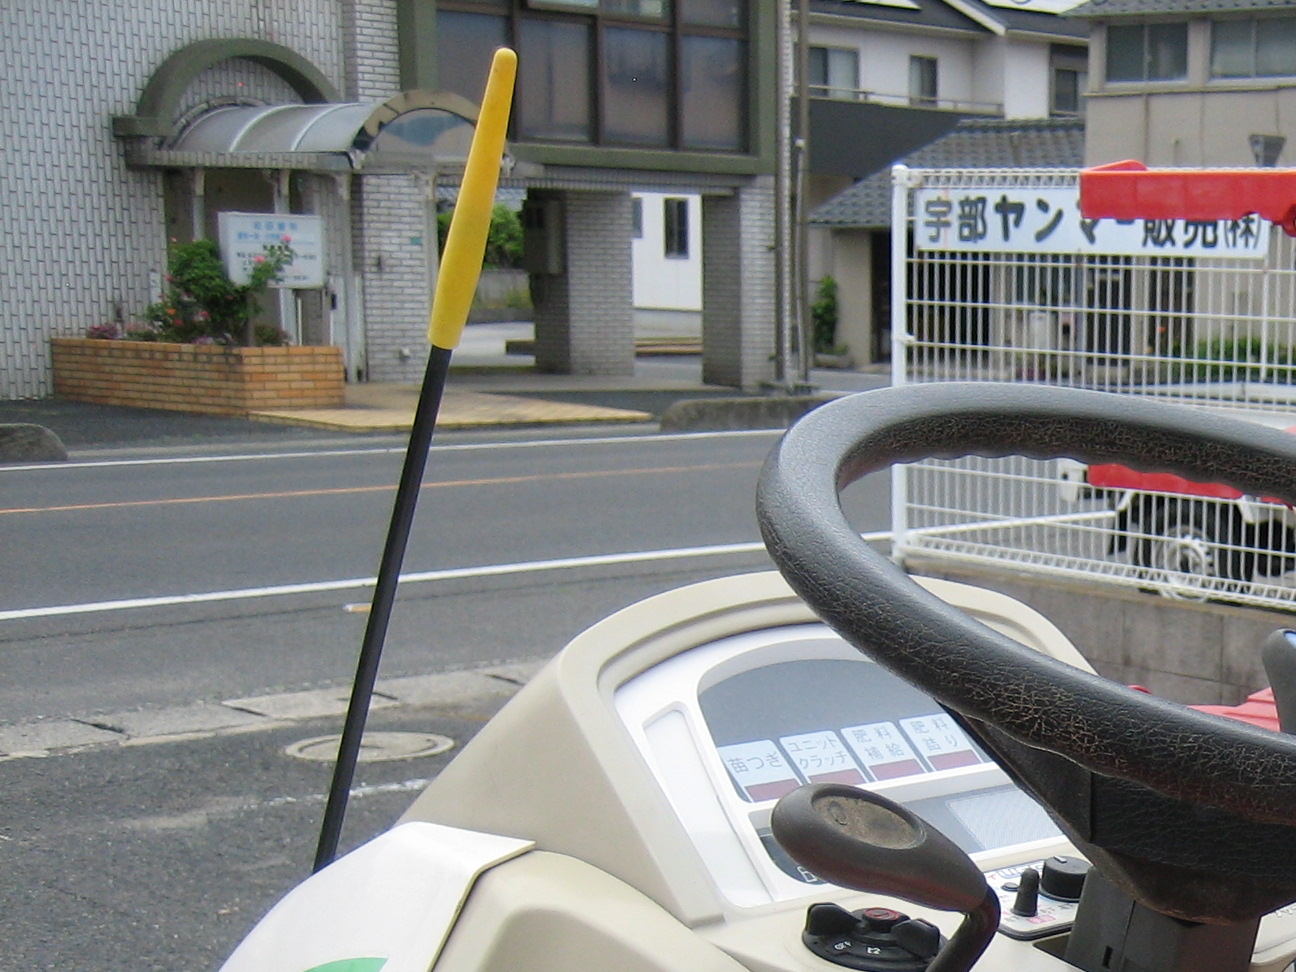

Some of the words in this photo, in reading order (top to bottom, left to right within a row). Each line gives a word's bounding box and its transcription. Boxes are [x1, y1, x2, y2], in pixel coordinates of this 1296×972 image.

[786, 735, 839, 754] ユニット
[726, 751, 784, 775] 苗つぎ
[797, 750, 850, 771] クラッチ
